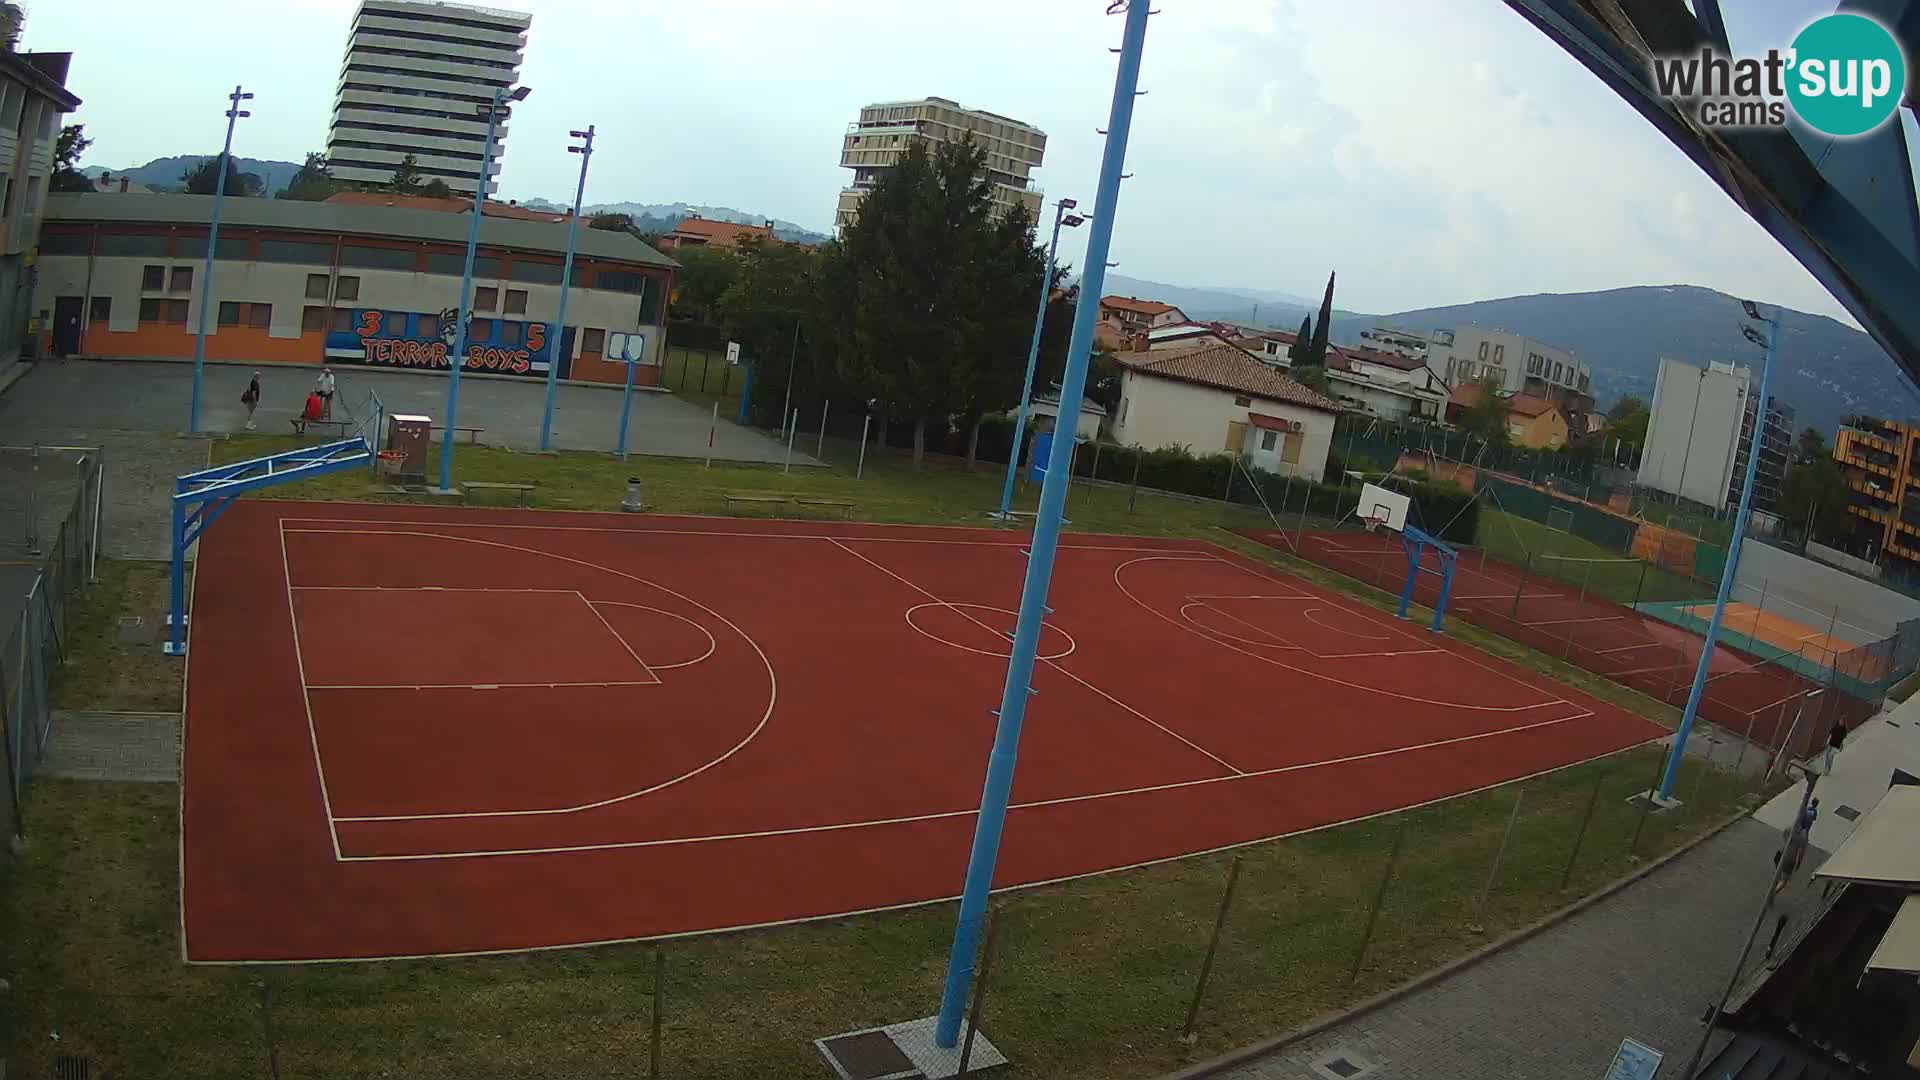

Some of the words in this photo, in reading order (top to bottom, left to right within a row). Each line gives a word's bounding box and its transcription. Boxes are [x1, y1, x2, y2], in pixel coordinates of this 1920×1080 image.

[357, 311, 383, 337] 3
[527, 324, 545, 350] 5
[361, 339, 448, 367] TERROR
[468, 346, 530, 373] BOYS
